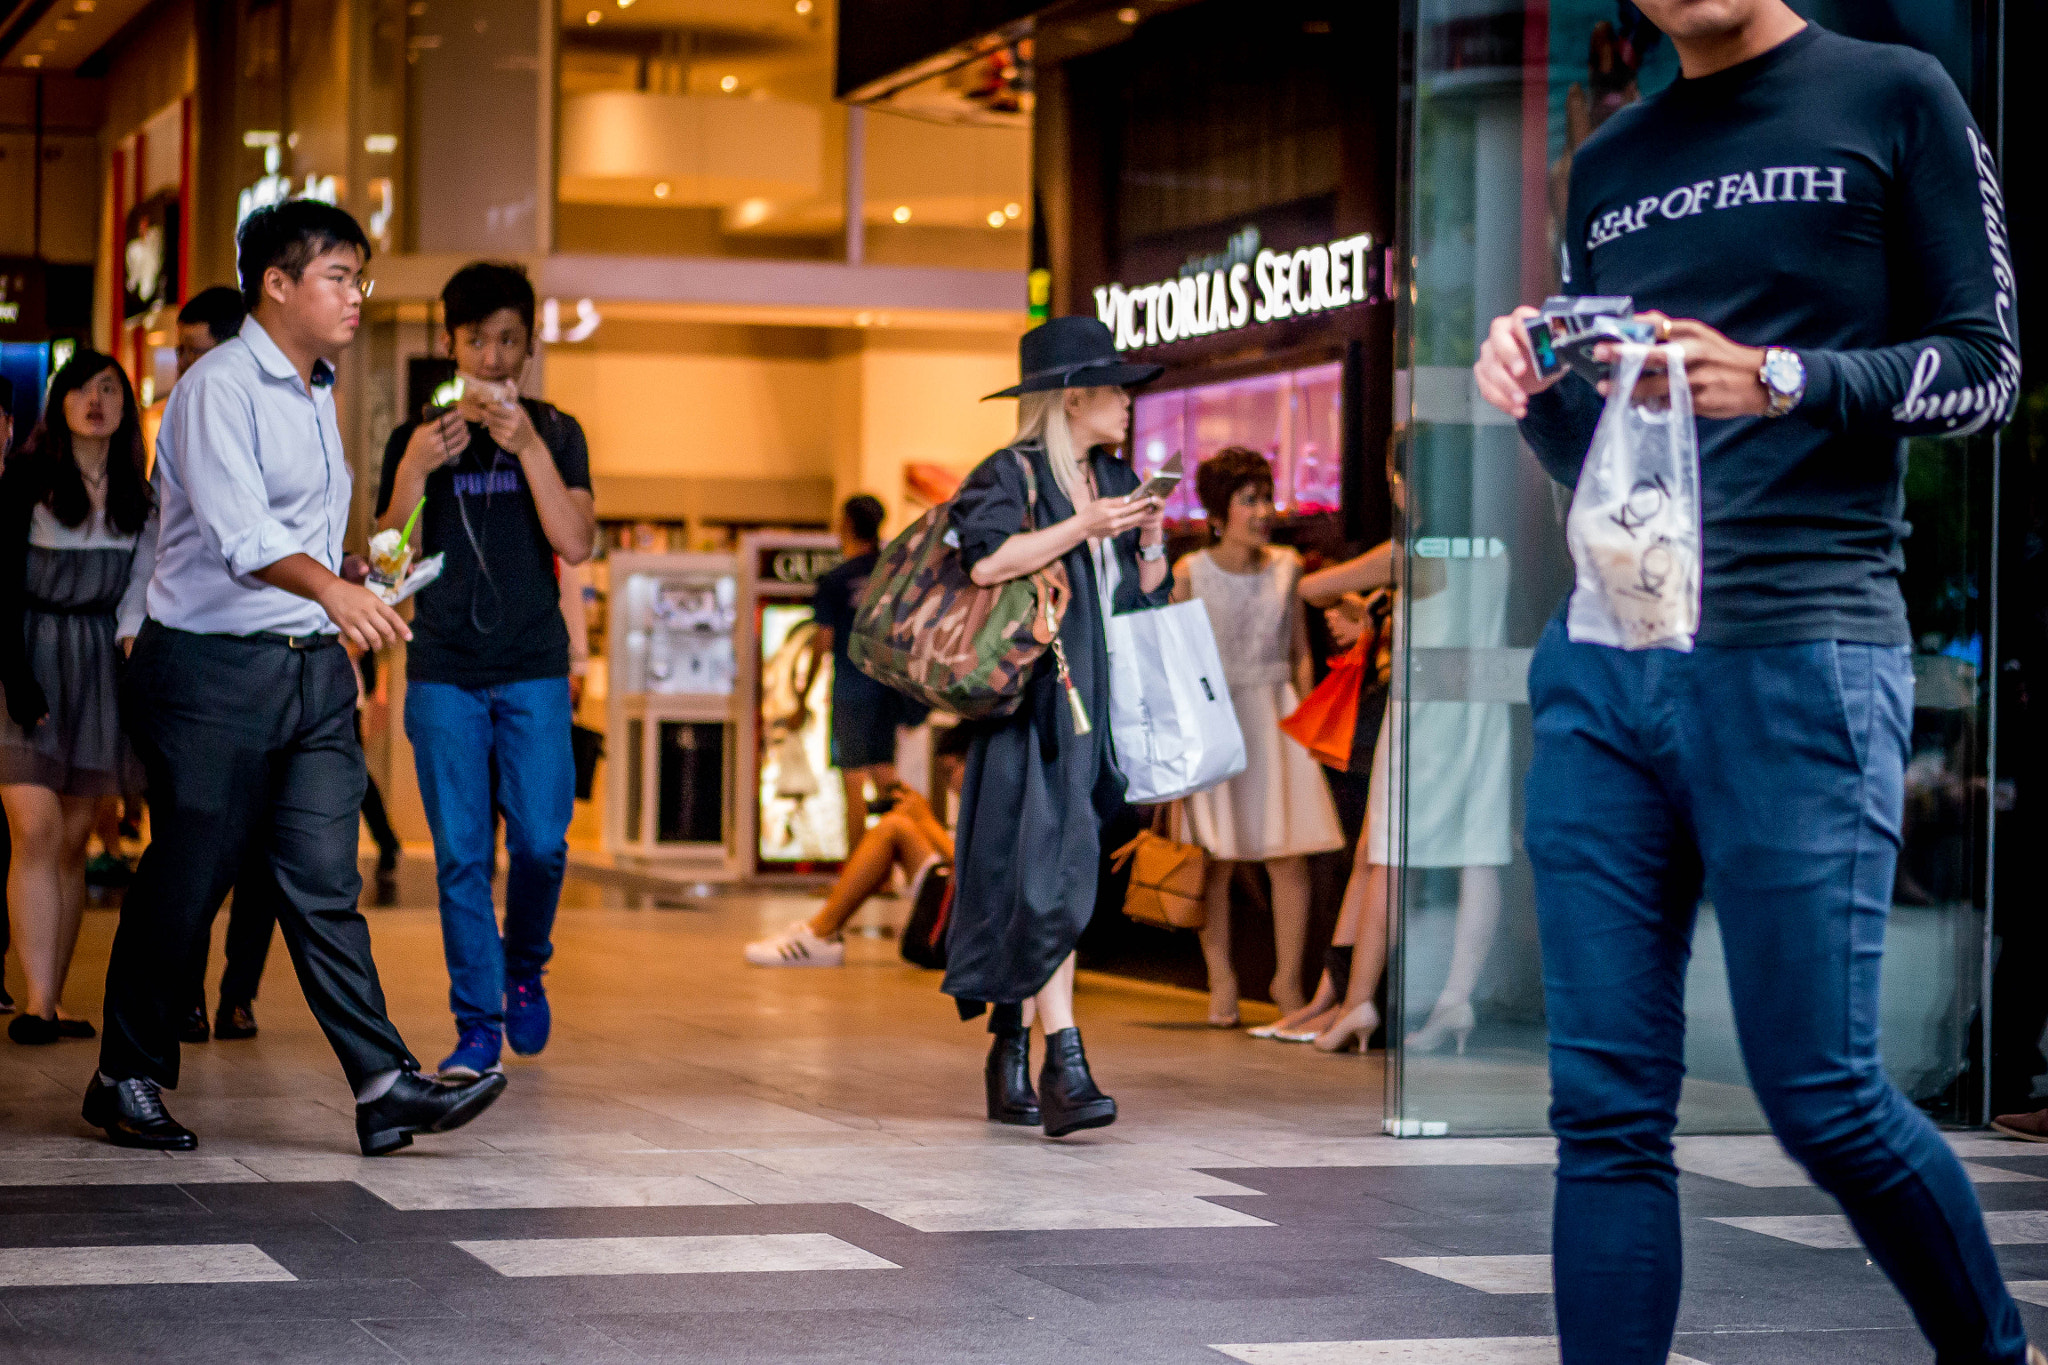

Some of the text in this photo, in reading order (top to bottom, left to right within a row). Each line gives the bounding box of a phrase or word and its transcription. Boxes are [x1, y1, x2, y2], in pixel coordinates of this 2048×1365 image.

[1659, 180, 1715, 220] OF
[1713, 166, 1848, 204] FAITH
[1254, 234, 1371, 322] SECRET
[1608, 472, 1672, 540] KOI
